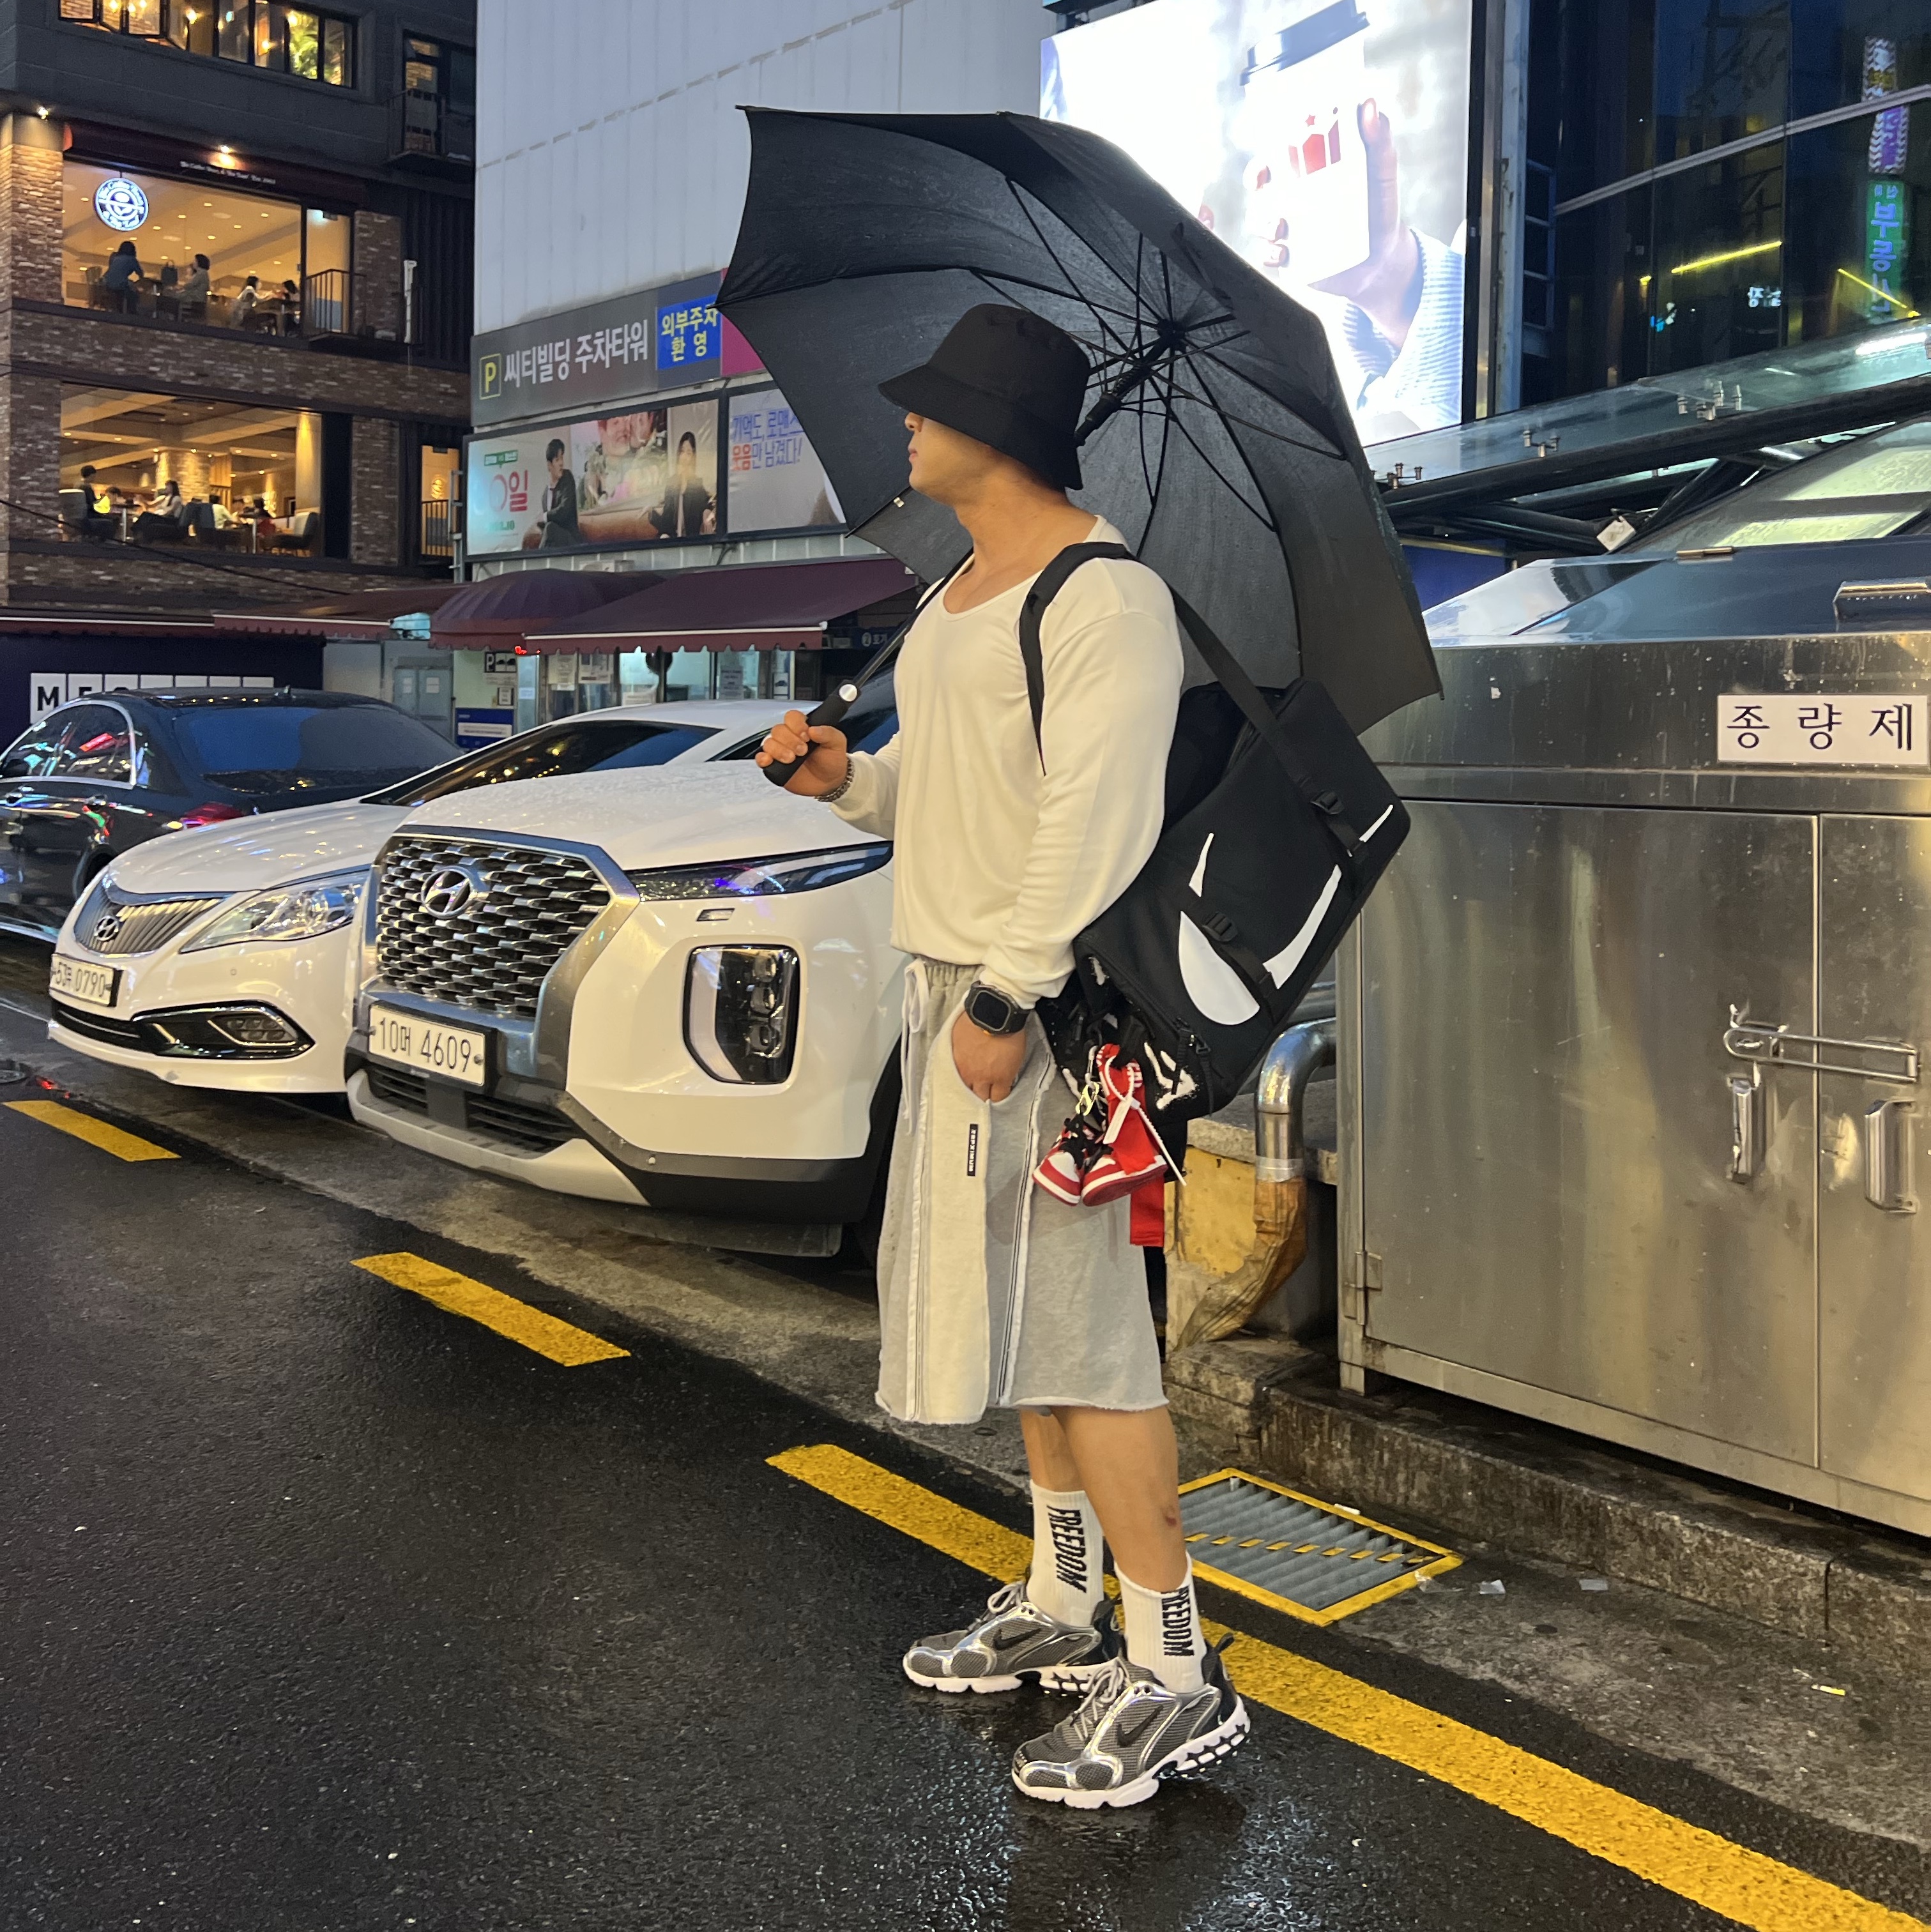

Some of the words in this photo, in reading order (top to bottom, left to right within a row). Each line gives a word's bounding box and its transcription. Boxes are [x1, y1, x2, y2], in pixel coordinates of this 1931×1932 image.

[661, 302, 719, 337] 외부주차
[504, 338, 570, 388] 씨티빌딩
[575, 319, 648, 374] 주차타워
[485, 361, 496, 393] P
[75, 968, 105, 998] 0790
[420, 1030, 471, 1073] 4609
[1046, 1505, 1087, 1594] FREEDOM
